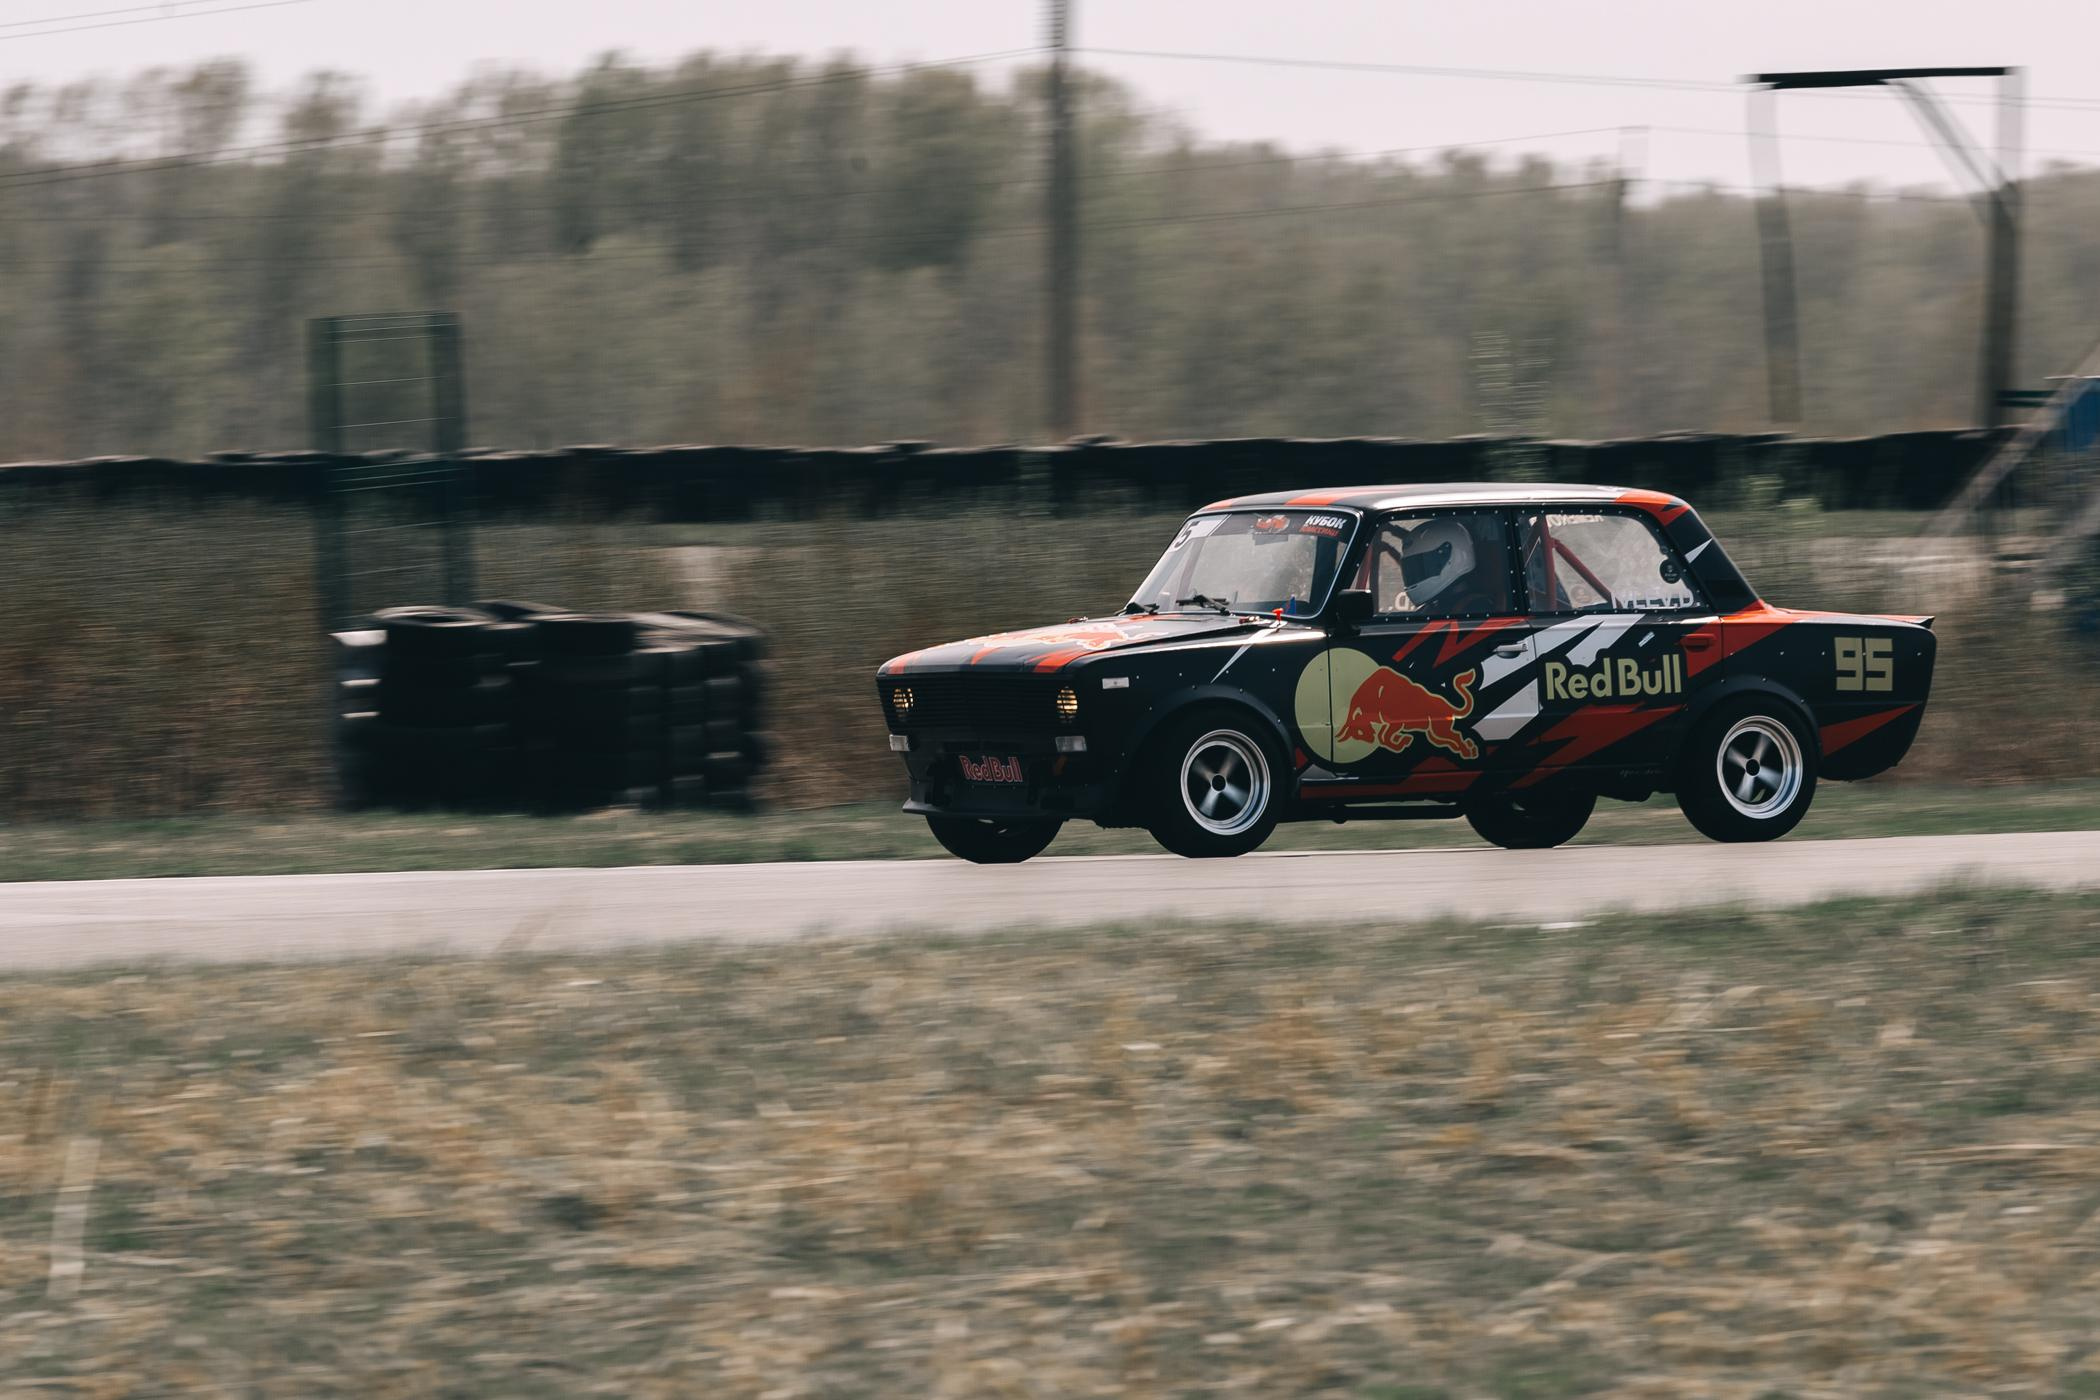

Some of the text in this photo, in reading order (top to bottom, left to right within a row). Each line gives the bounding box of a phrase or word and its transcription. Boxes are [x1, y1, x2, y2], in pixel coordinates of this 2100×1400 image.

[1304, 515, 1347, 529] КУБОК
[1545, 654, 1682, 700] Red Bull
[1834, 637, 1893, 691] 95
[959, 754, 1023, 782] Red Bull
